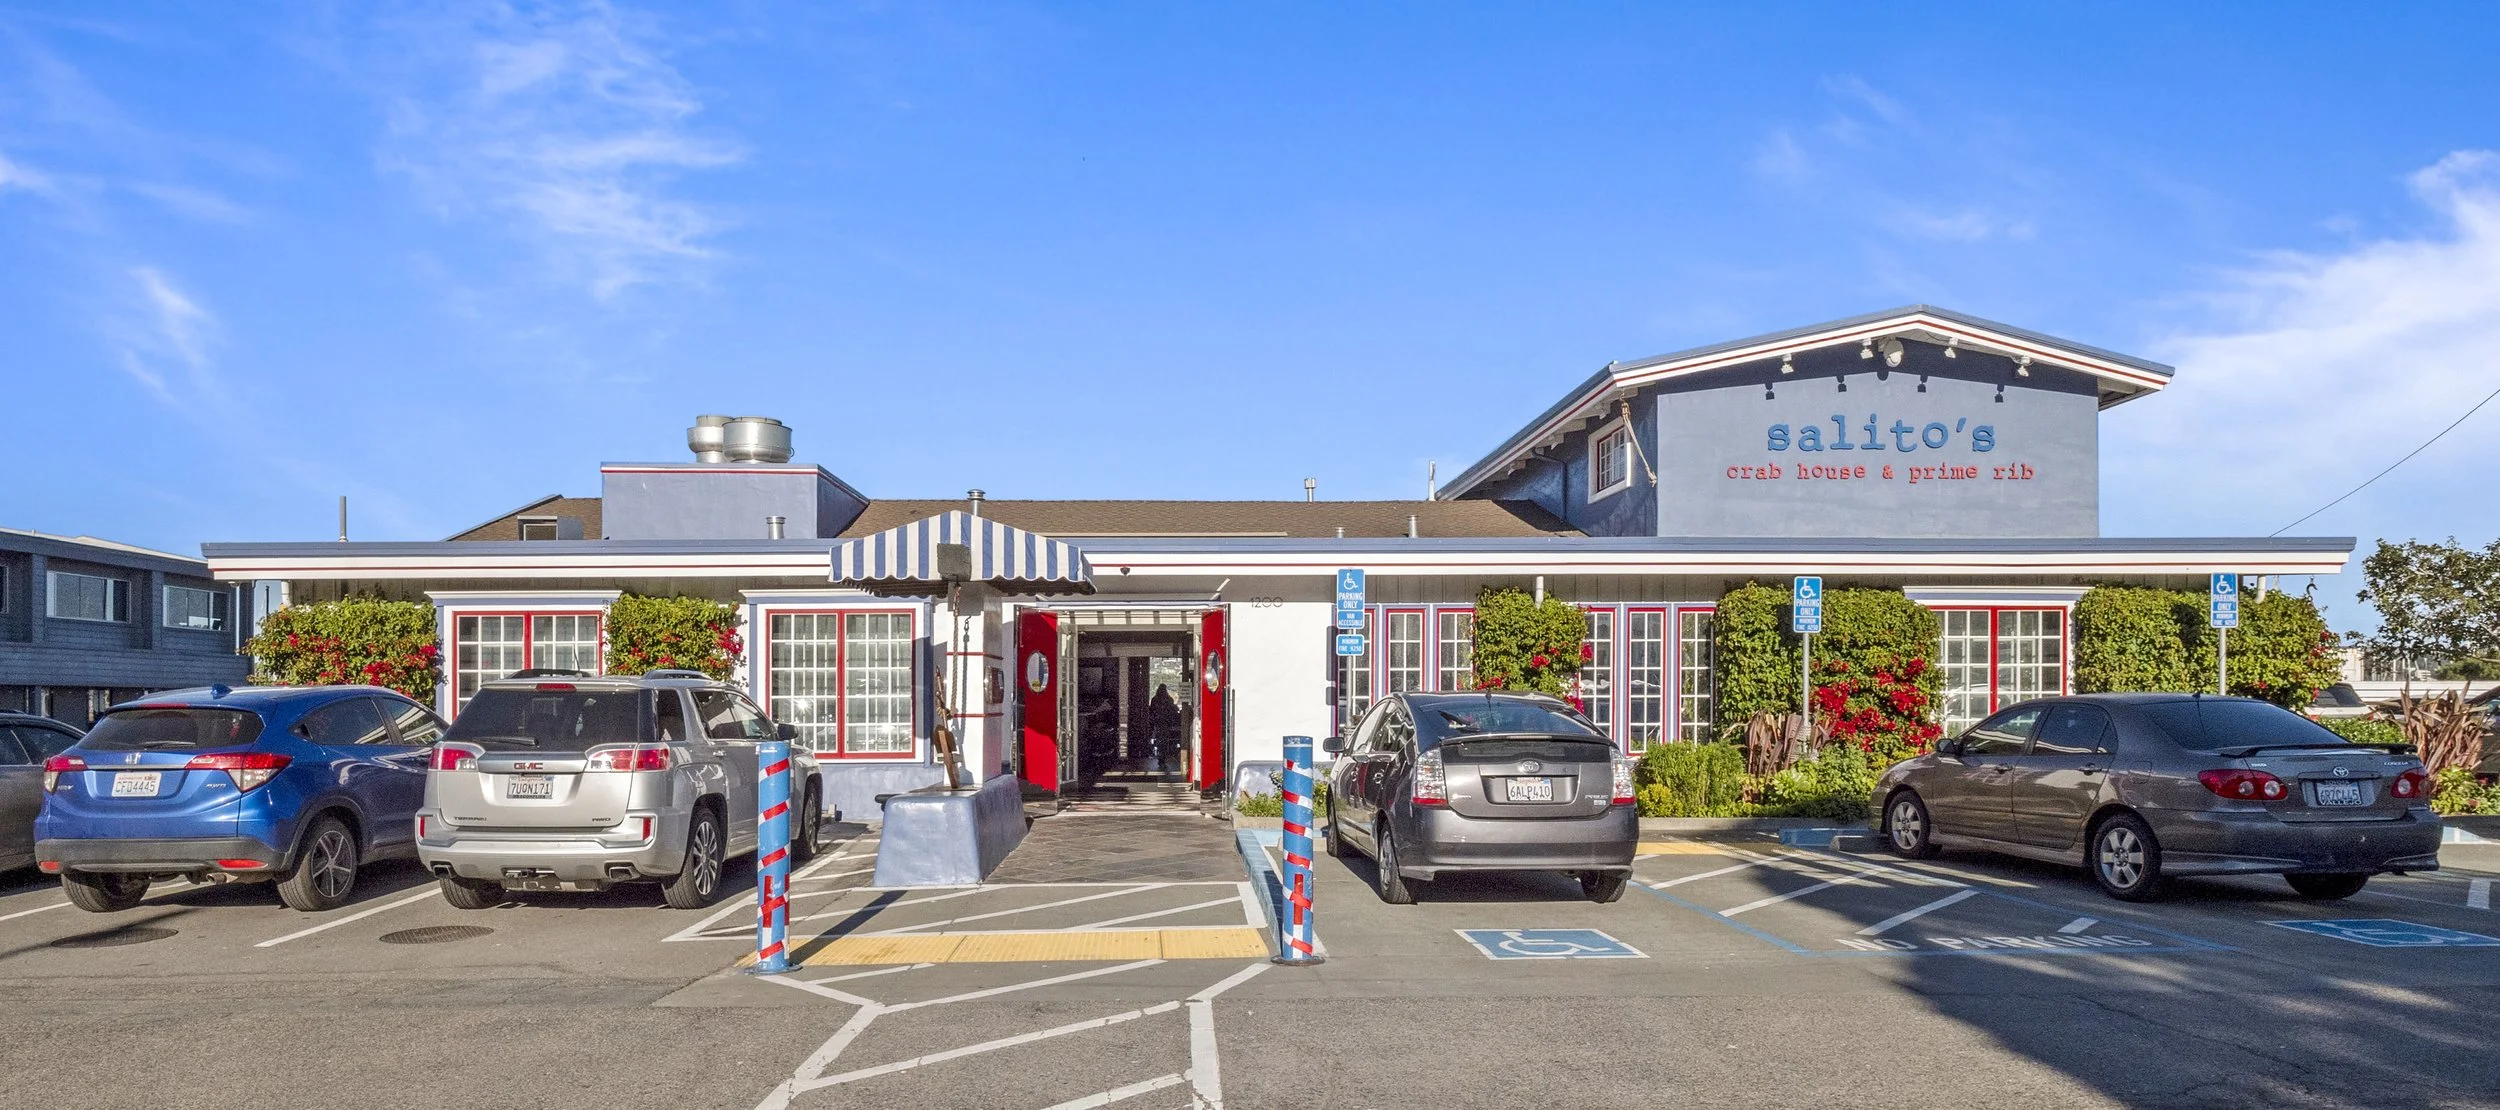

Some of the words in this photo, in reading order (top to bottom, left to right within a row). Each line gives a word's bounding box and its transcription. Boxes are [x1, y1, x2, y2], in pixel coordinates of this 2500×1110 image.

[1767, 413, 1997, 452] salito's
[1726, 462, 1783, 480] crab
[1797, 462, 1866, 480] house
[1882, 463, 1895, 480] &
[1908, 461, 1978, 484] prime
[1993, 462, 2035, 480] rib
[1338, 592, 1363, 600] PARKING
[2213, 594, 2236, 602] PARKING
[1249, 596, 1284, 608] 1200
[1343, 600, 1359, 609] ONLY
[1796, 599, 1820, 607] PARKING
[2217, 602, 2232, 611] ONLY
[1800, 607, 1815, 616] ONLY
[513, 762, 544, 770] GMC
[1510, 785, 1551, 798] 6ALP410
[1834, 937, 1919, 951] NO
[1925, 934, 2153, 950] PARKING
